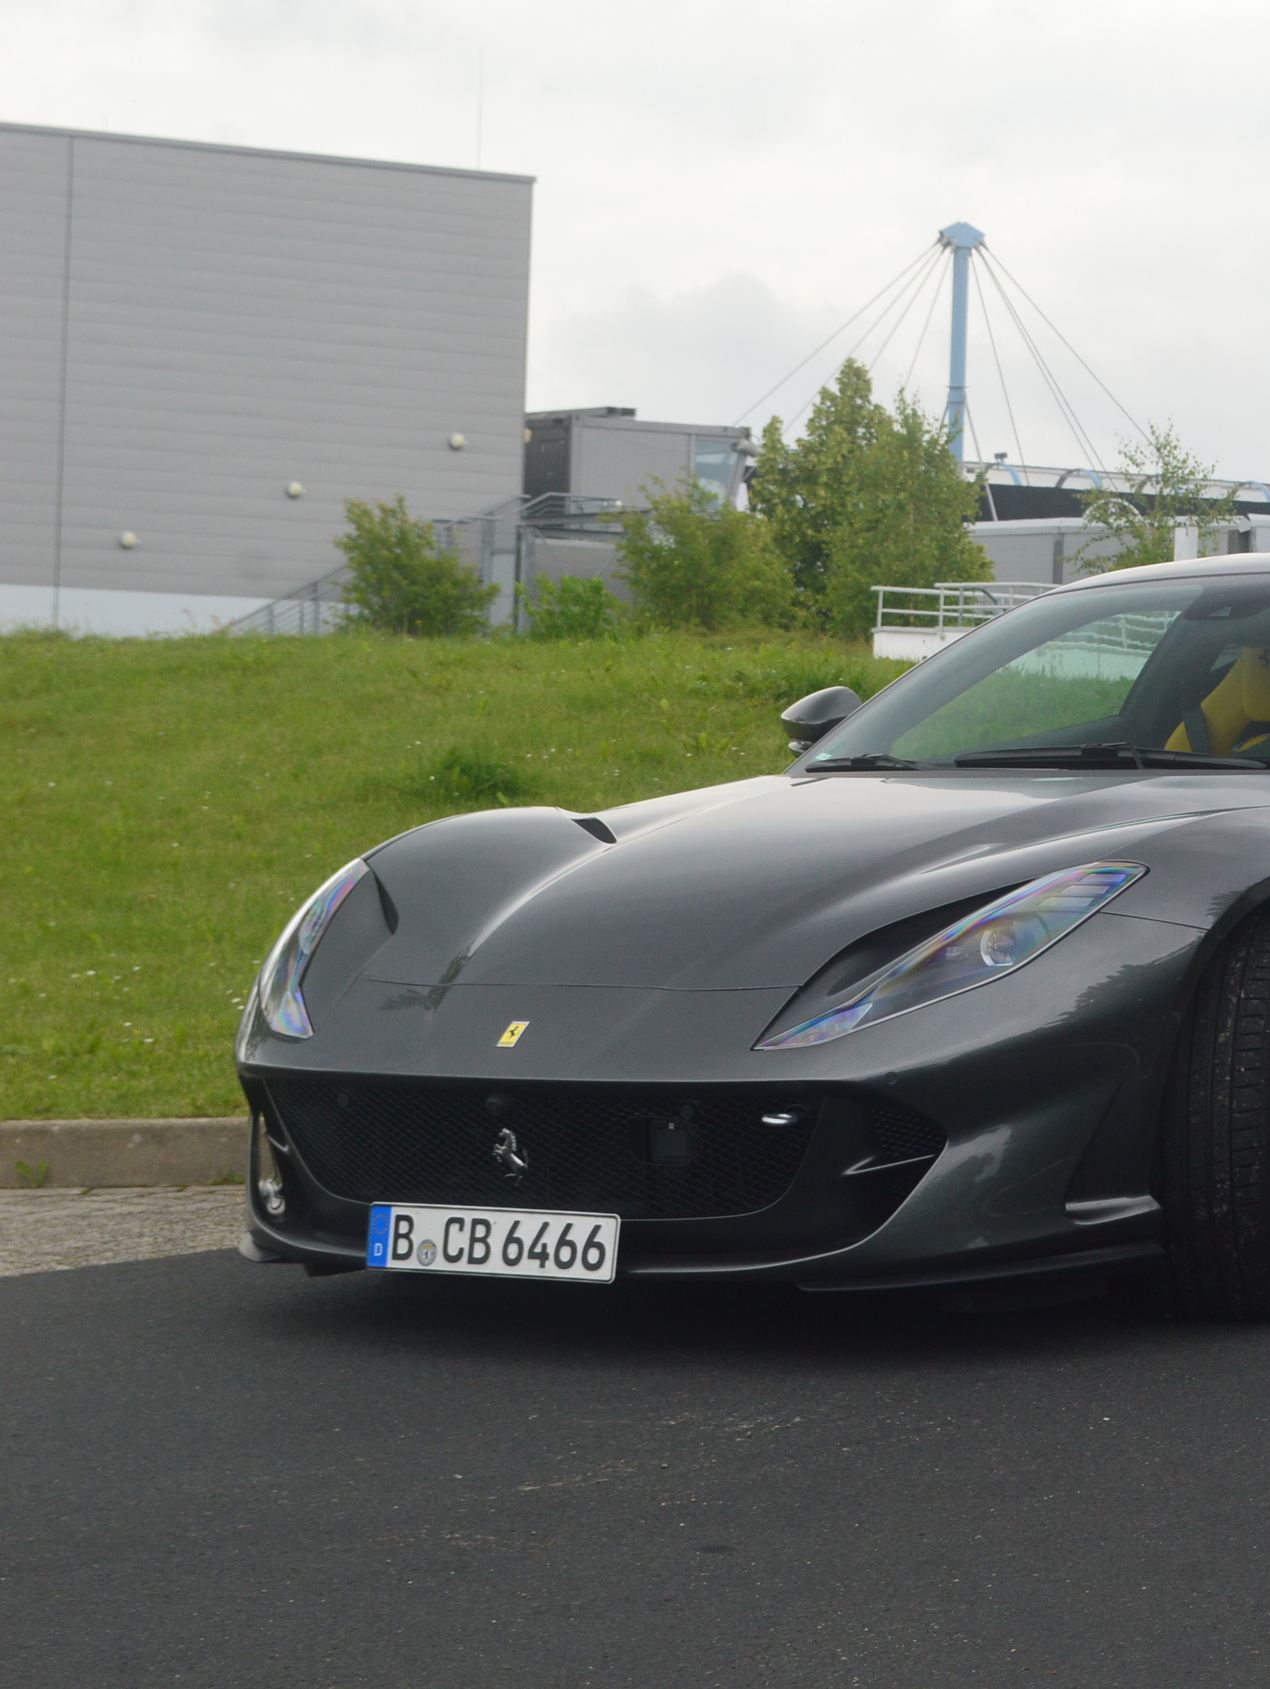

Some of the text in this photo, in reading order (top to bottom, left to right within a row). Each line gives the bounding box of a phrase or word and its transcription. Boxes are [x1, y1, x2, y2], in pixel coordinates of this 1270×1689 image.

[374, 1243, 383, 1256] D
[391, 1214, 607, 1272] B CB 6466
